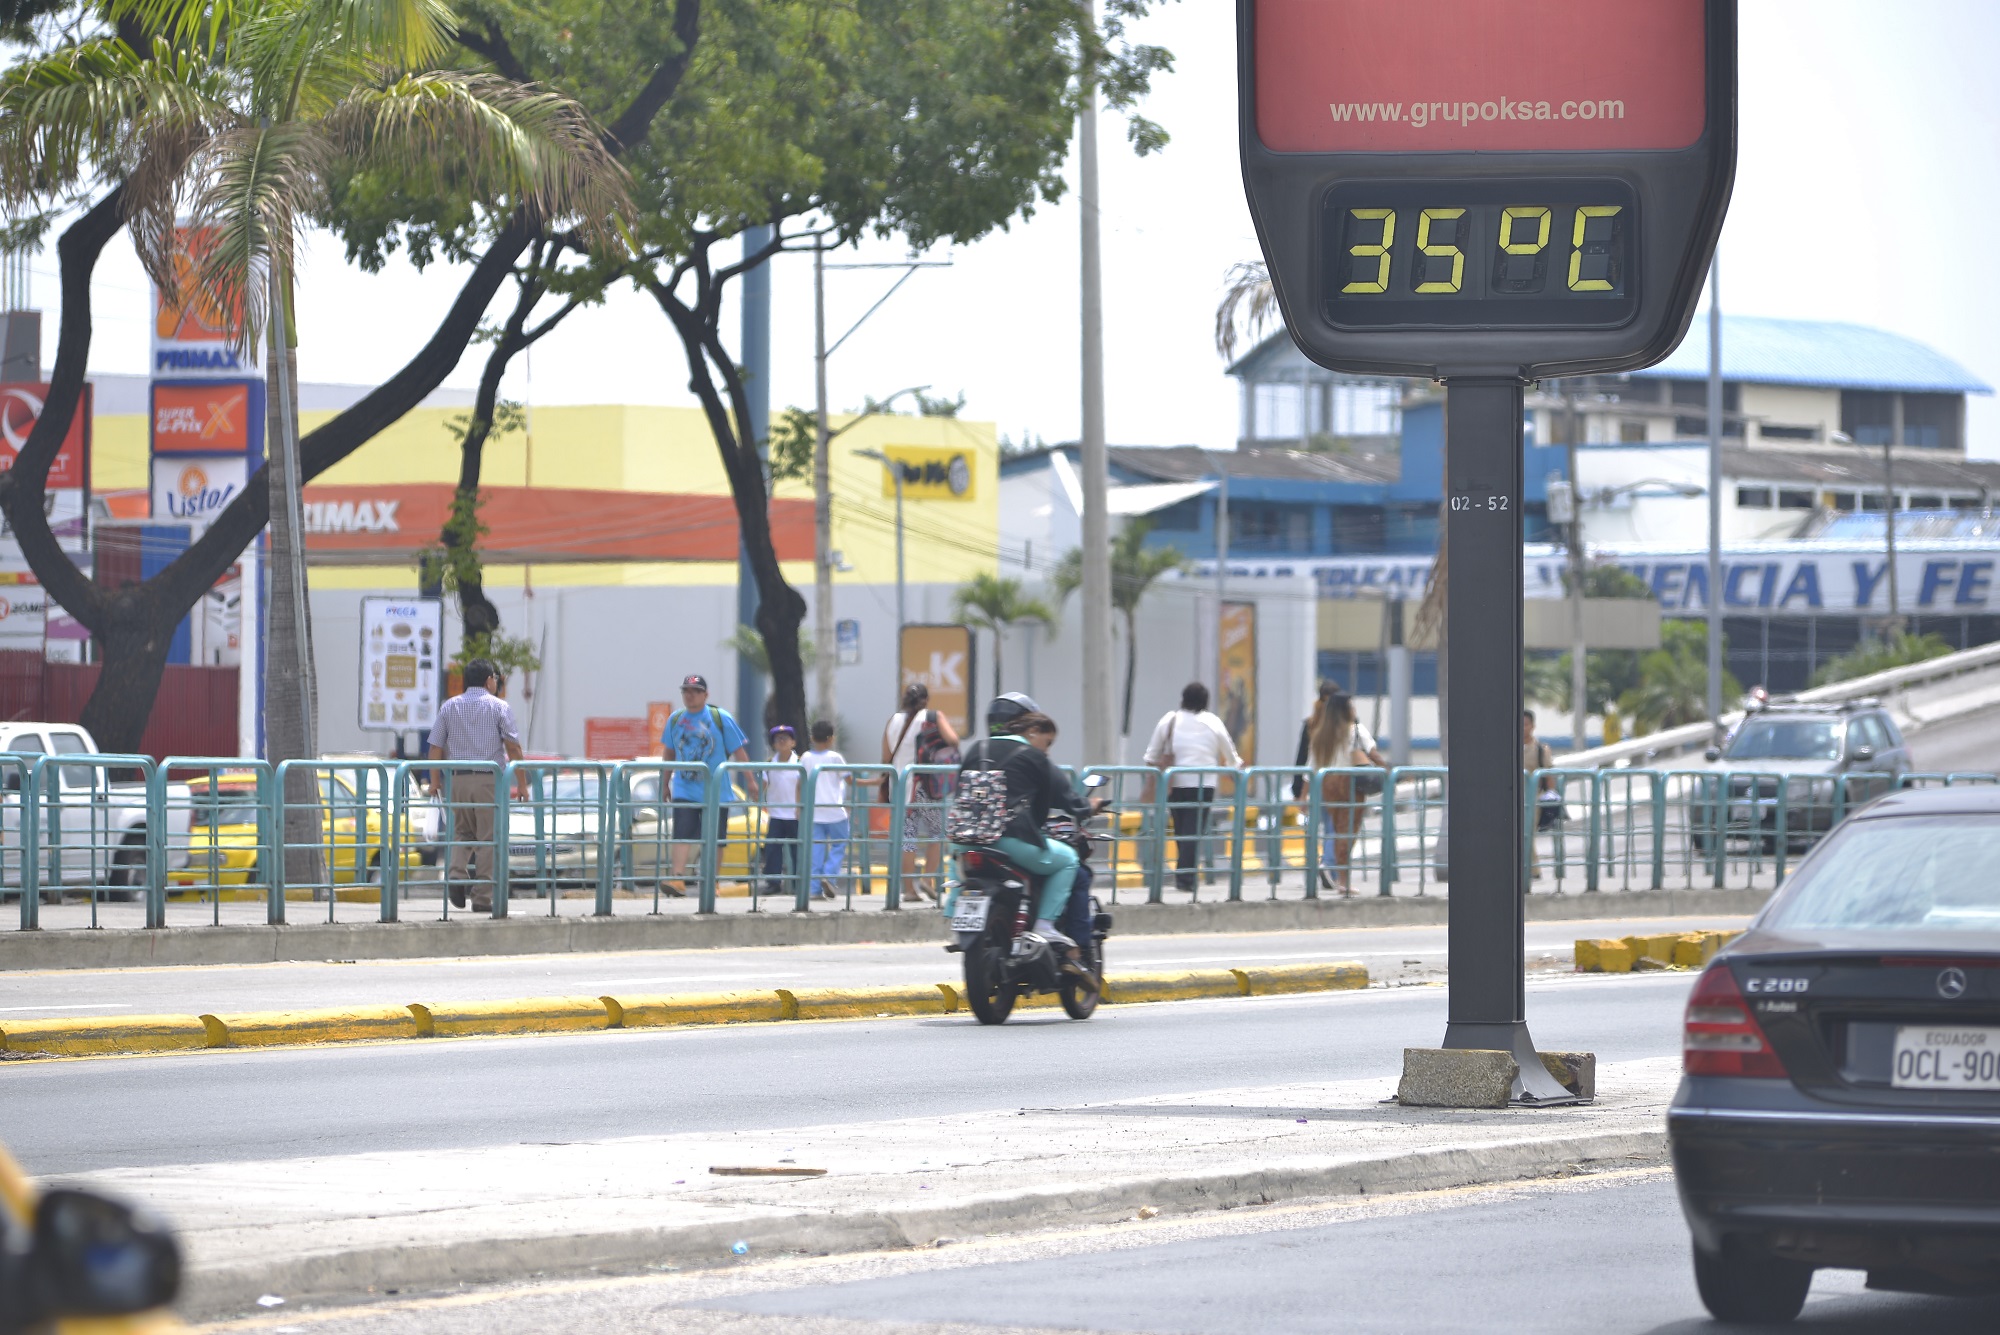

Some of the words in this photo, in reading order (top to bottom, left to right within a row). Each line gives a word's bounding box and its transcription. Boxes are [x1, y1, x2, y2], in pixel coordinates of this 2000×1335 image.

[1329, 96, 1625, 127] www.grupoksa.com
[157, 407, 195, 419] SUPER
[167, 483, 235, 518] Listo!
[303, 499, 400, 533] IMAX
[1851, 560, 1890, 606] Y
[1917, 558, 1994, 605] FE
[1925, 1032, 1987, 1046] ECUADOR
[1897, 1049, 2000, 1081] OCL-90
